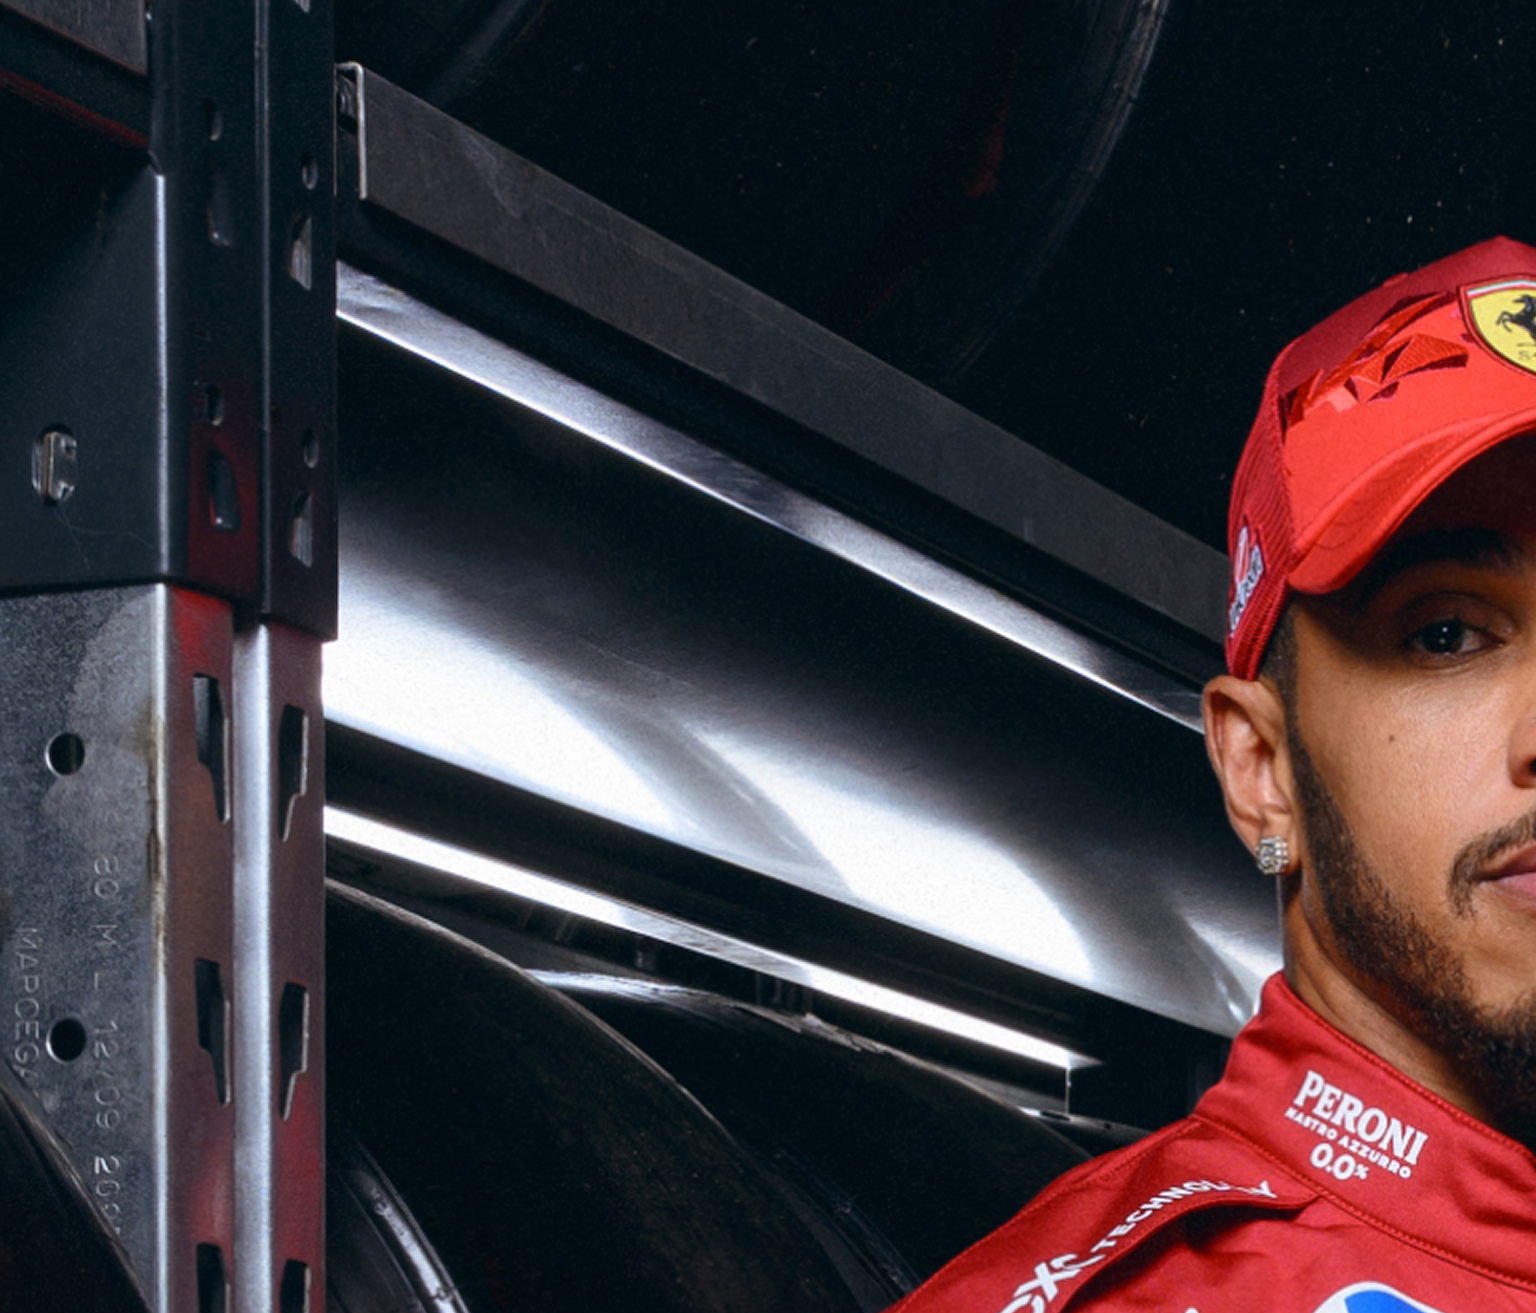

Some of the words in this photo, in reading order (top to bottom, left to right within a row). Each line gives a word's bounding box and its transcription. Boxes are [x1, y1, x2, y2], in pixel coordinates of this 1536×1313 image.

[1283, 1106, 1339, 1141] NASTRO
[1337, 1135, 1412, 1179] AZZURRO
[1292, 1069, 1429, 1166] PERONI
[1309, 1142, 1370, 1181] 0.0%
